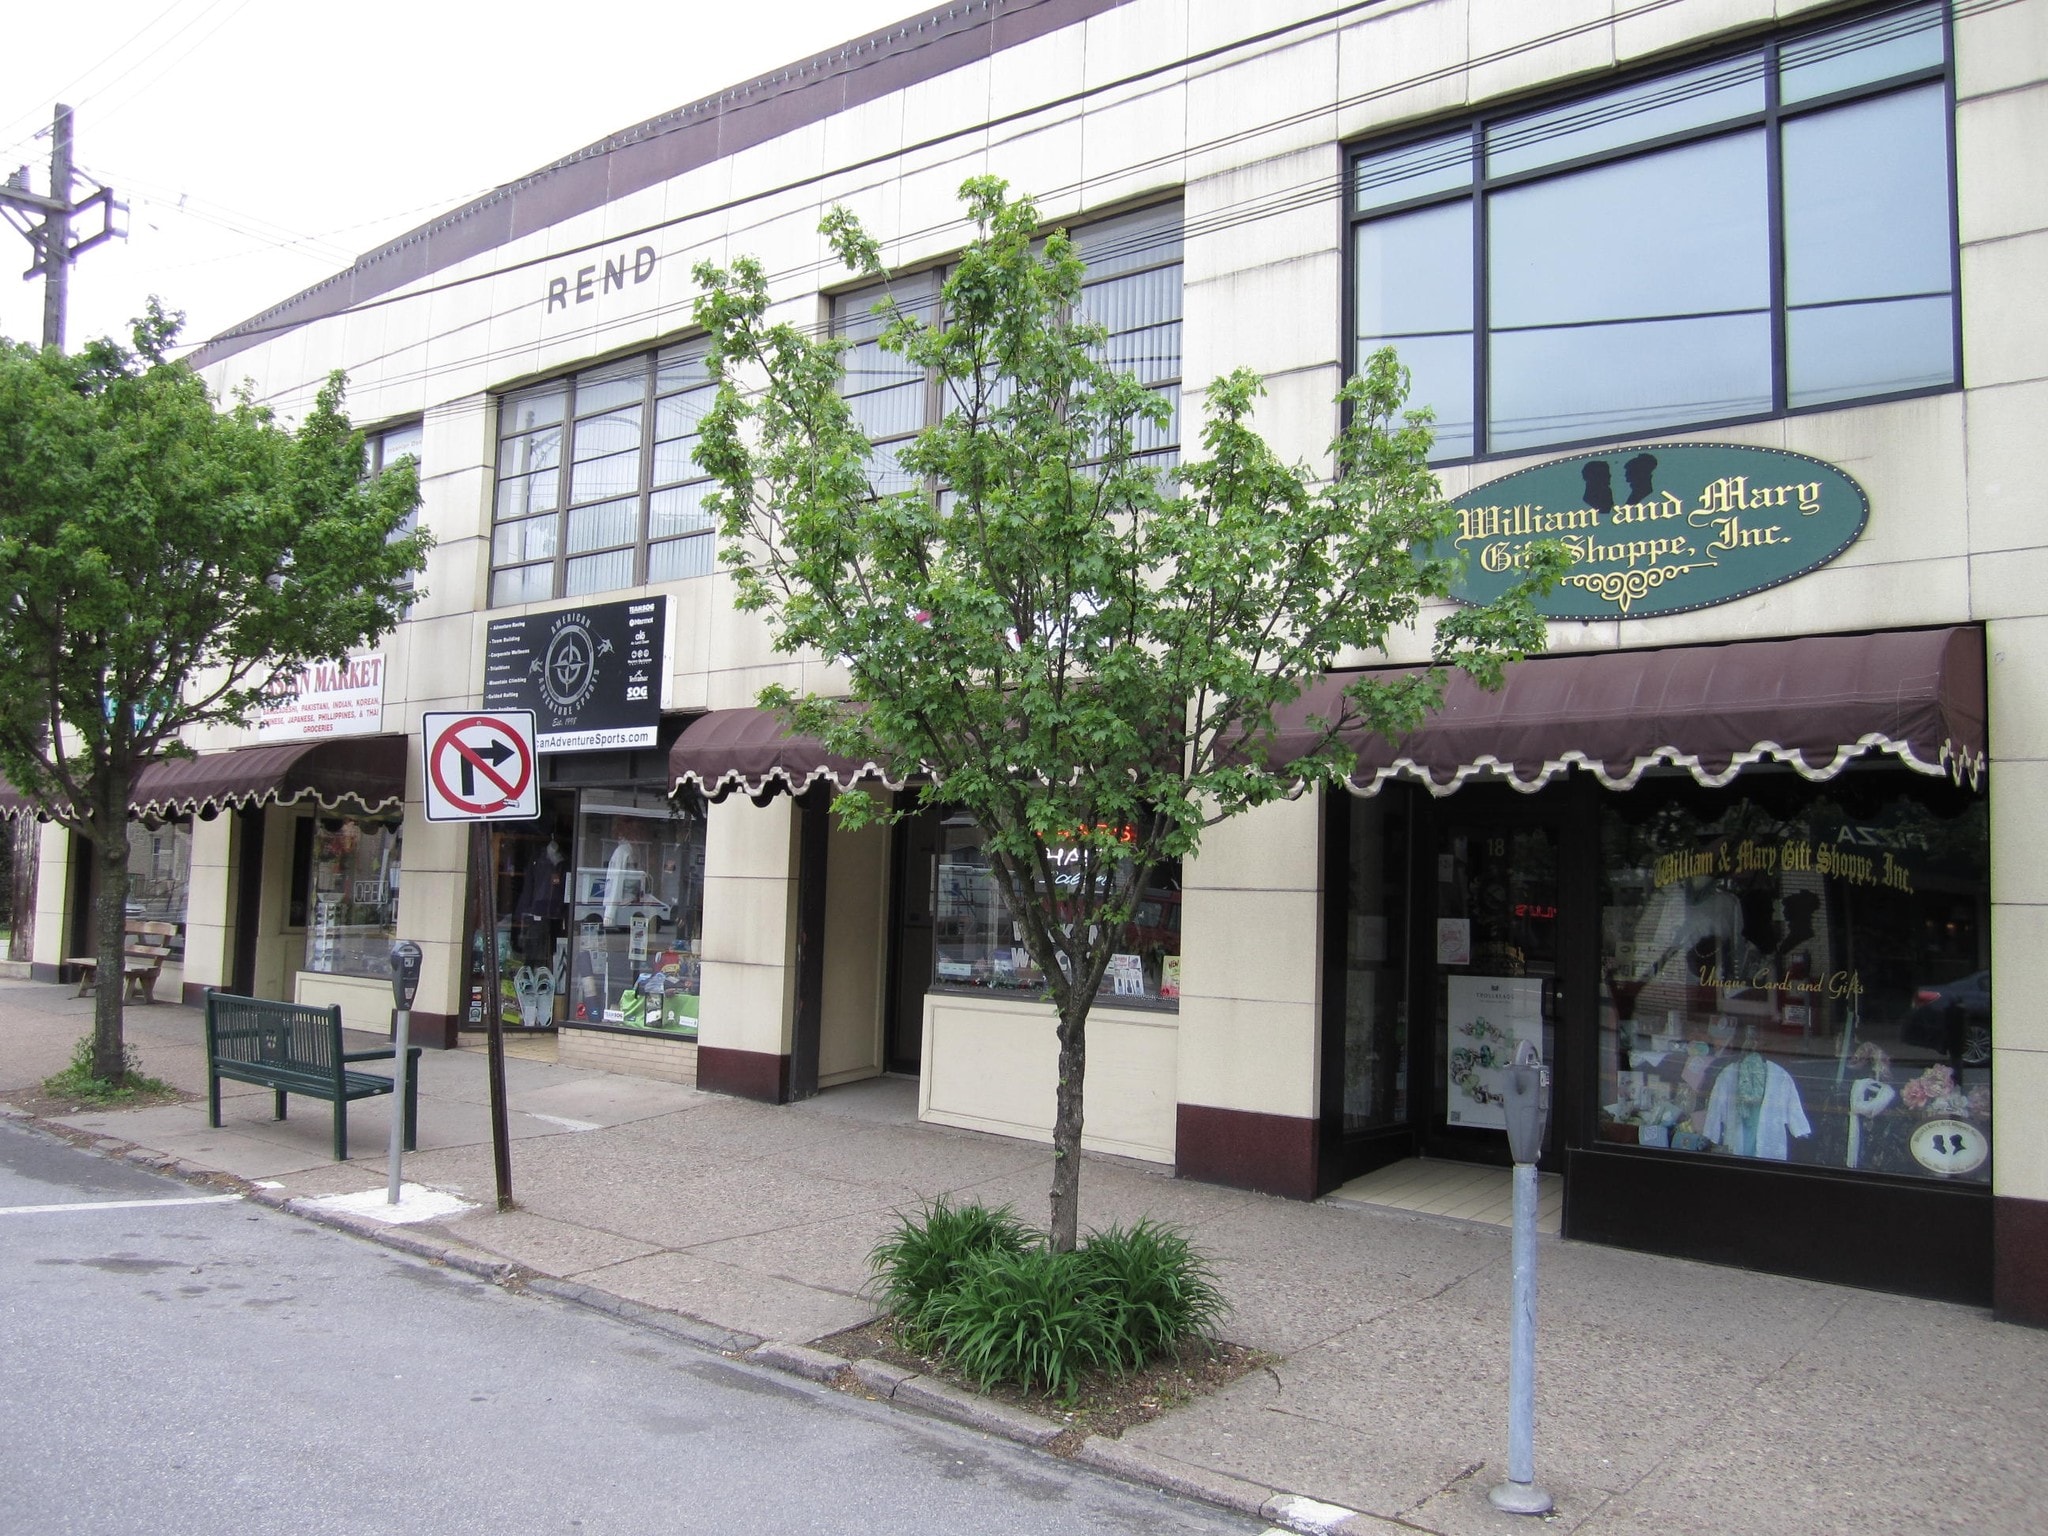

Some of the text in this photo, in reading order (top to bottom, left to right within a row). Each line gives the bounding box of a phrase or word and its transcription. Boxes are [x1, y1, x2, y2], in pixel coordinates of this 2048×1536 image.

[547, 246, 656, 314] REND
[1454, 475, 1823, 549] William and Mary
[1480, 516, 1792, 572] Gif Shoppe, Inc.
[551, 613, 591, 635] AMERICAN
[314, 658, 381, 693] MARKET
[538, 669, 600, 716] ADVENTURE SPORTS
[627, 685, 648, 698] SOG
[303, 723, 334, 733] GROCERIES
[366, 708, 379, 717] THAI
[1487, 838, 1505, 856] 18
[1654, 839, 1914, 895] William & Mary Gift Shoppe, Inc.
[355, 881, 388, 902] OPEN
[1700, 965, 1864, 1000] Unique Cards and Gifts
